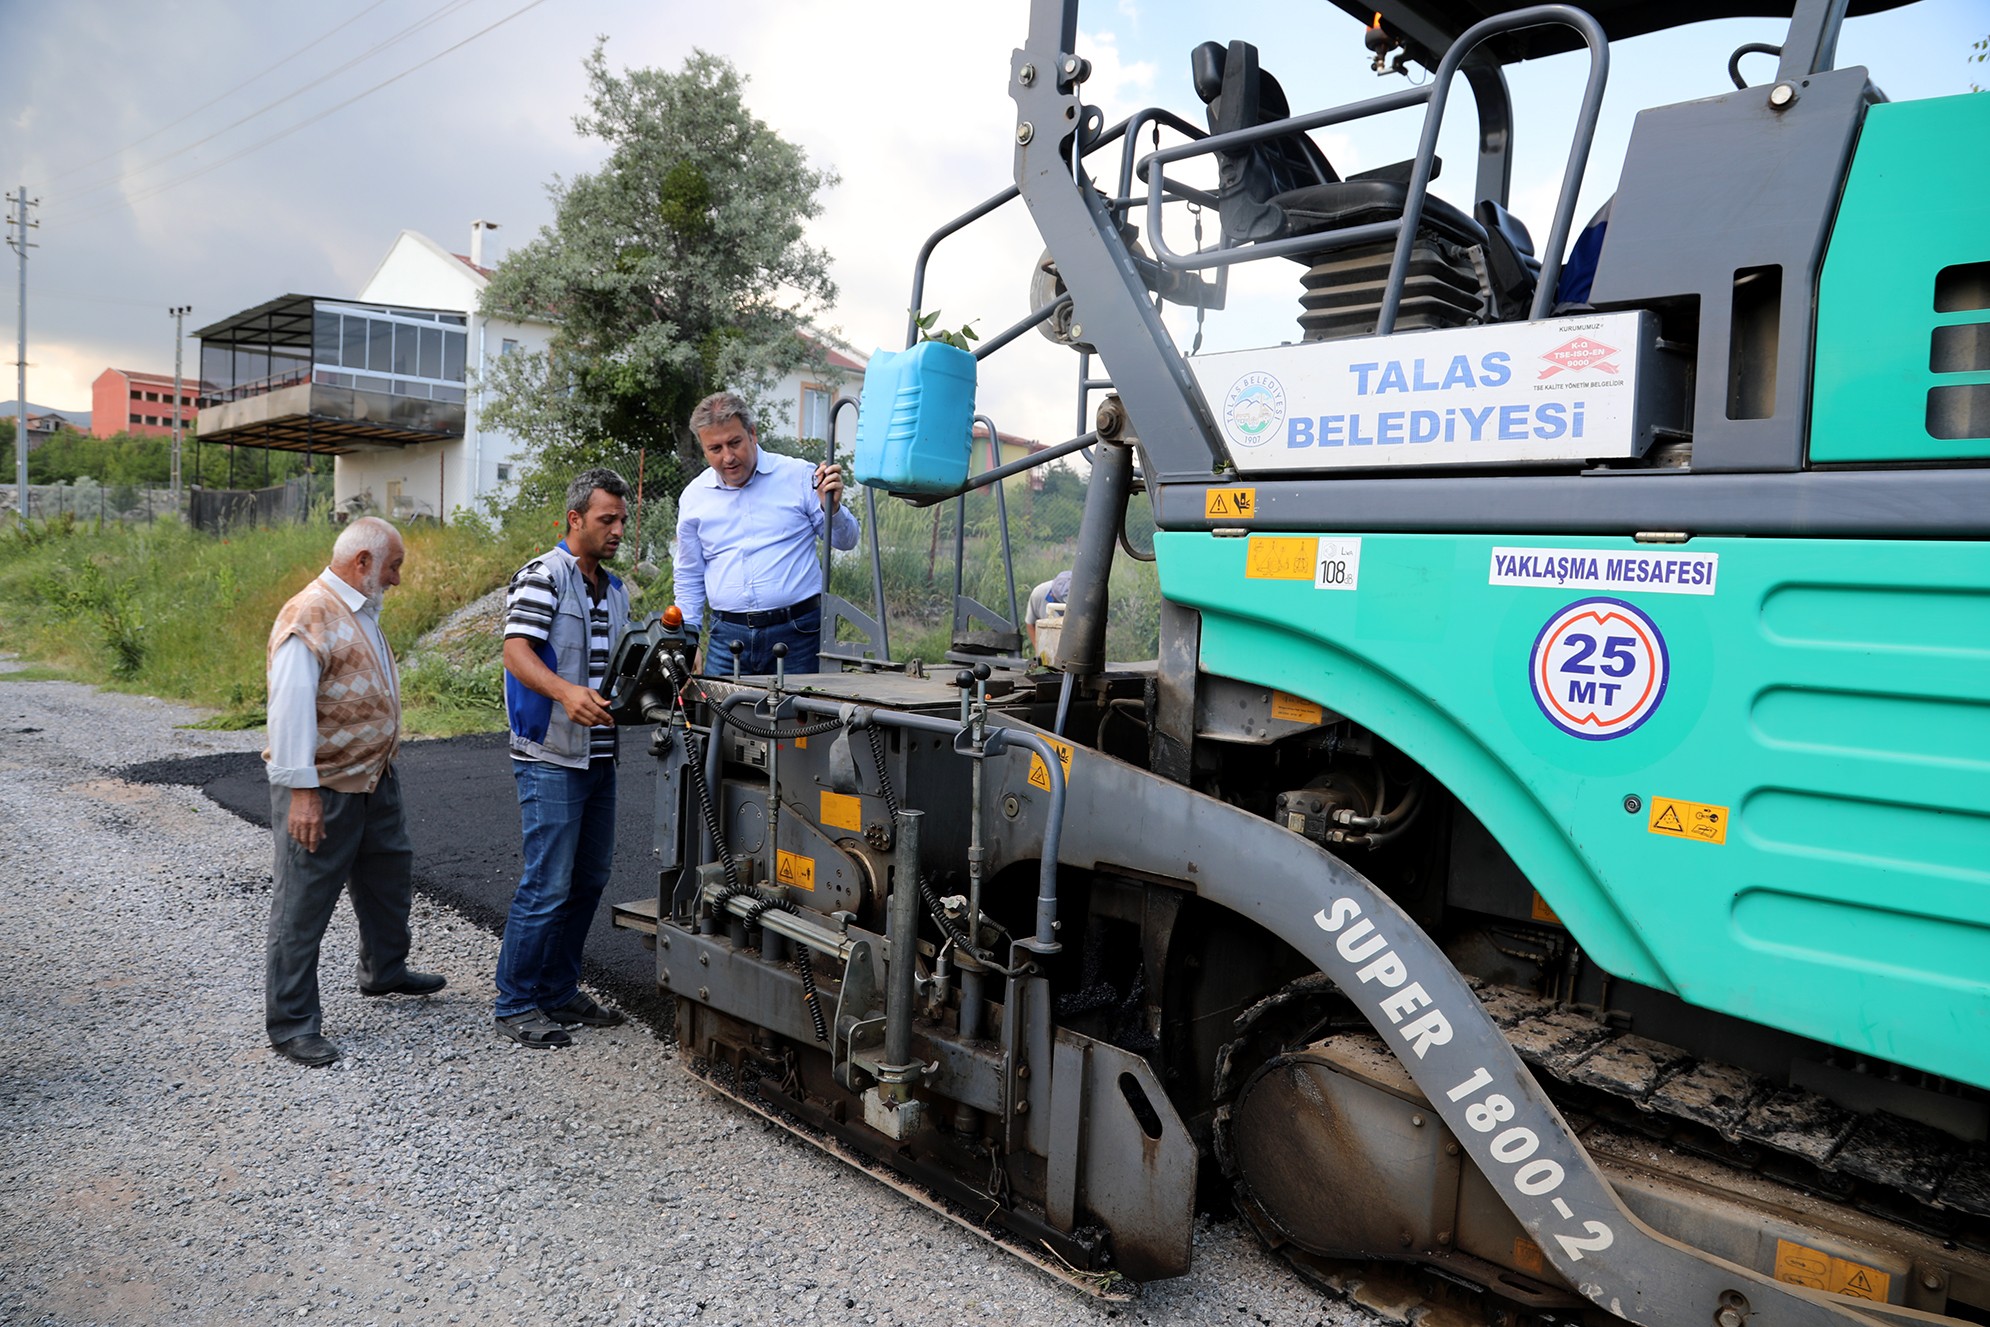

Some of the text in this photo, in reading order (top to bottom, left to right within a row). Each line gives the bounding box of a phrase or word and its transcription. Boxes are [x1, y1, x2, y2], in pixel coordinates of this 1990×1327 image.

[1554, 348, 1605, 359] TSE-ISO-EN
[1567, 359, 1590, 367] 9000
[1349, 351, 1512, 396] TALAS
[1226, 386, 1241, 424] TALAS
[1244, 435, 1261, 444] 1907
[1320, 560, 1345, 584] 108
[1495, 554, 1599, 584] YAKLAŞMA
[1560, 633, 1637, 678] 25
[1568, 680, 1622, 706] MT
[1313, 897, 1614, 1262] SUPER 1800-2
